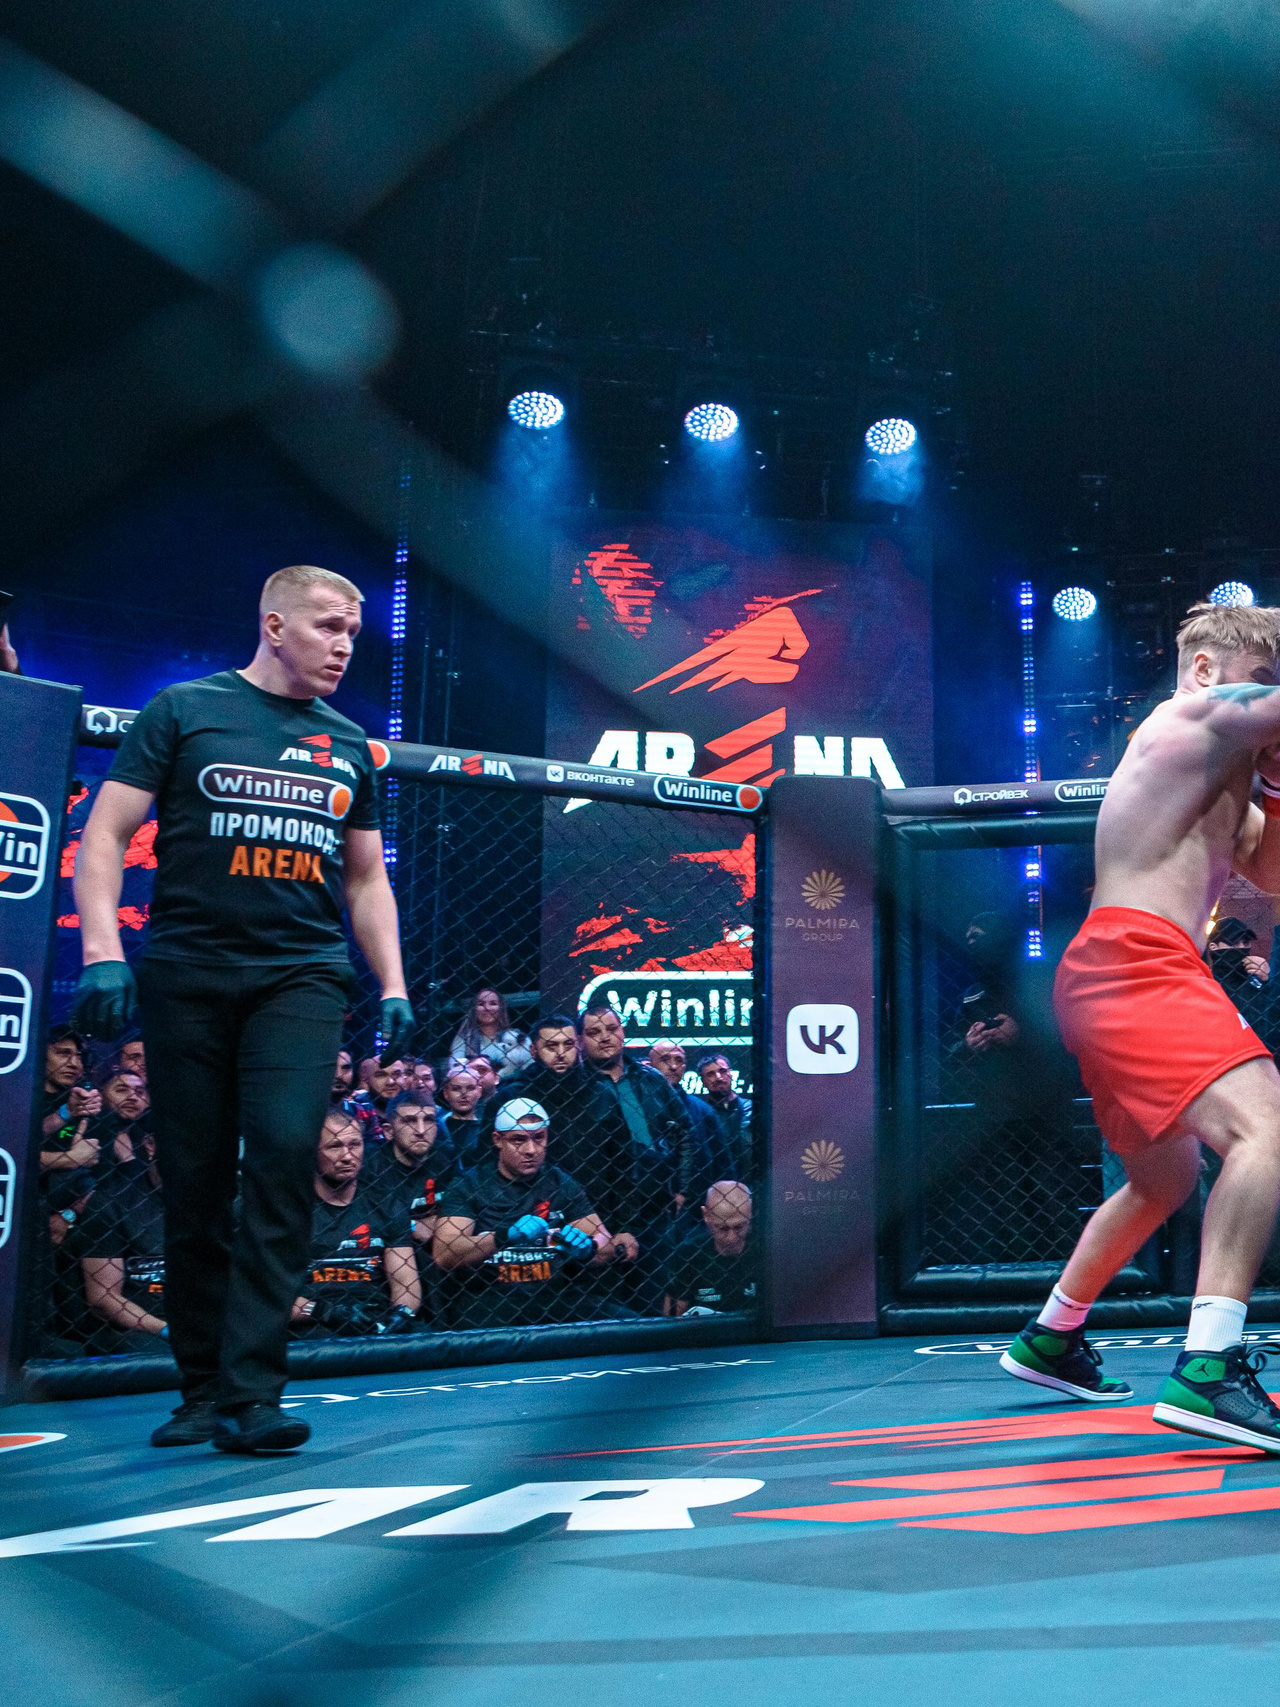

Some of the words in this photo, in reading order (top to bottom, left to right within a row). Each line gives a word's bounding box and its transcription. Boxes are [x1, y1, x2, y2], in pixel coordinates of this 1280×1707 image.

[279, 747, 357, 779] ARENA
[427, 753, 516, 782] ARENA
[213, 773, 324, 804] Winline
[664, 781, 733, 803] Winline
[1062, 784, 1108, 797] Winlin
[229, 845, 325, 884] ARENA
[785, 918, 860, 929] PALMIRA
[802, 933, 843, 942] GROUP
[607, 989, 753, 1027] Winli
